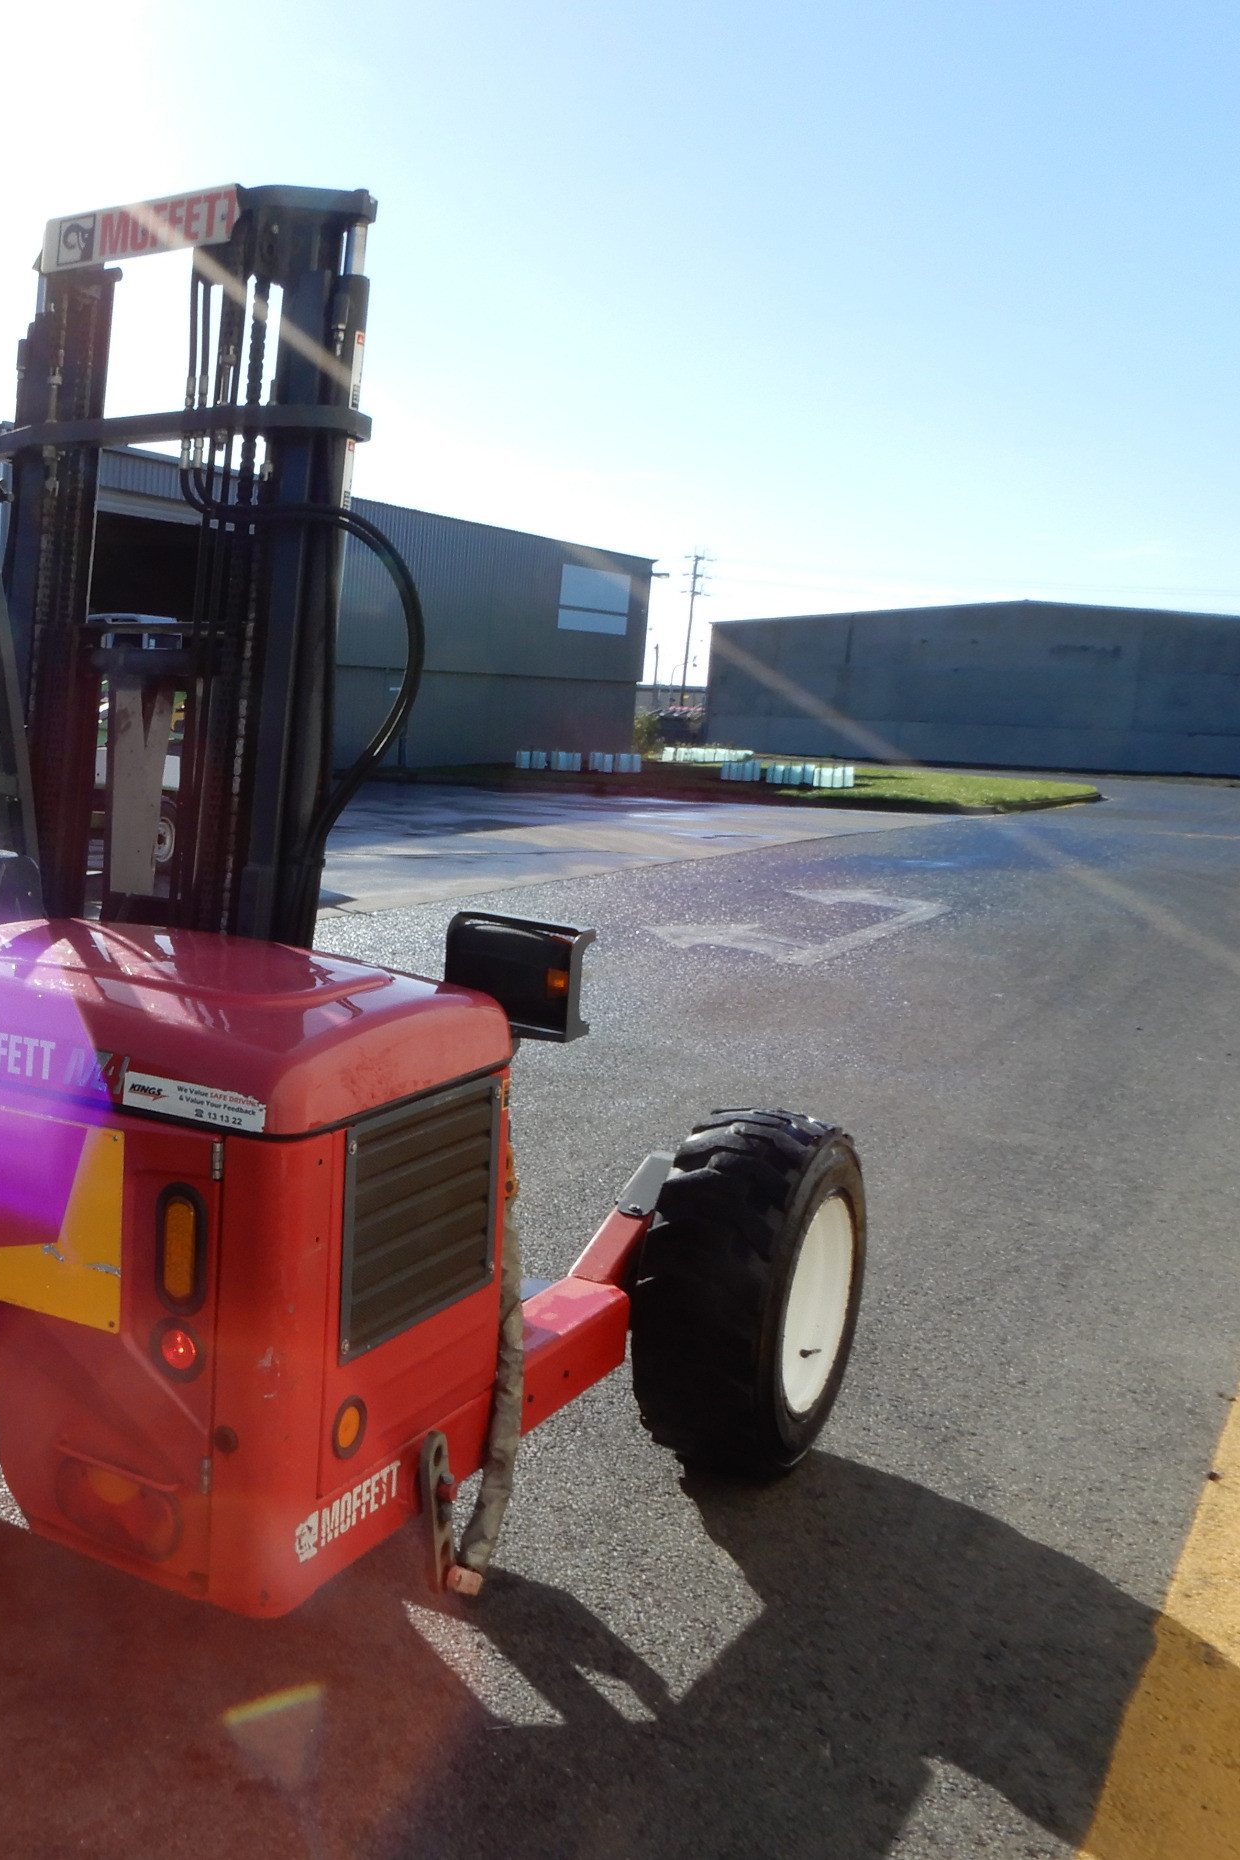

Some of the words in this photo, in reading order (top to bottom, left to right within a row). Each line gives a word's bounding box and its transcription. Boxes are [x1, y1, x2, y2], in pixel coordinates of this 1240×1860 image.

[98, 188, 238, 256] MOFFETT
[129, 1083, 163, 1096] KINGS
[177, 1085, 188, 1094] We
[188, 1088, 208, 1098] Value
[209, 1091, 228, 1102] SAFE
[185, 1096, 205, 1106] Value
[206, 1100, 222, 1109] Your
[223, 1103, 256, 1116] Feedback
[208, 1111, 217, 1121] 13
[220, 1113, 230, 1124] 13
[232, 1116, 243, 1126] 22
[320, 1460, 401, 1547] MOFFETT
